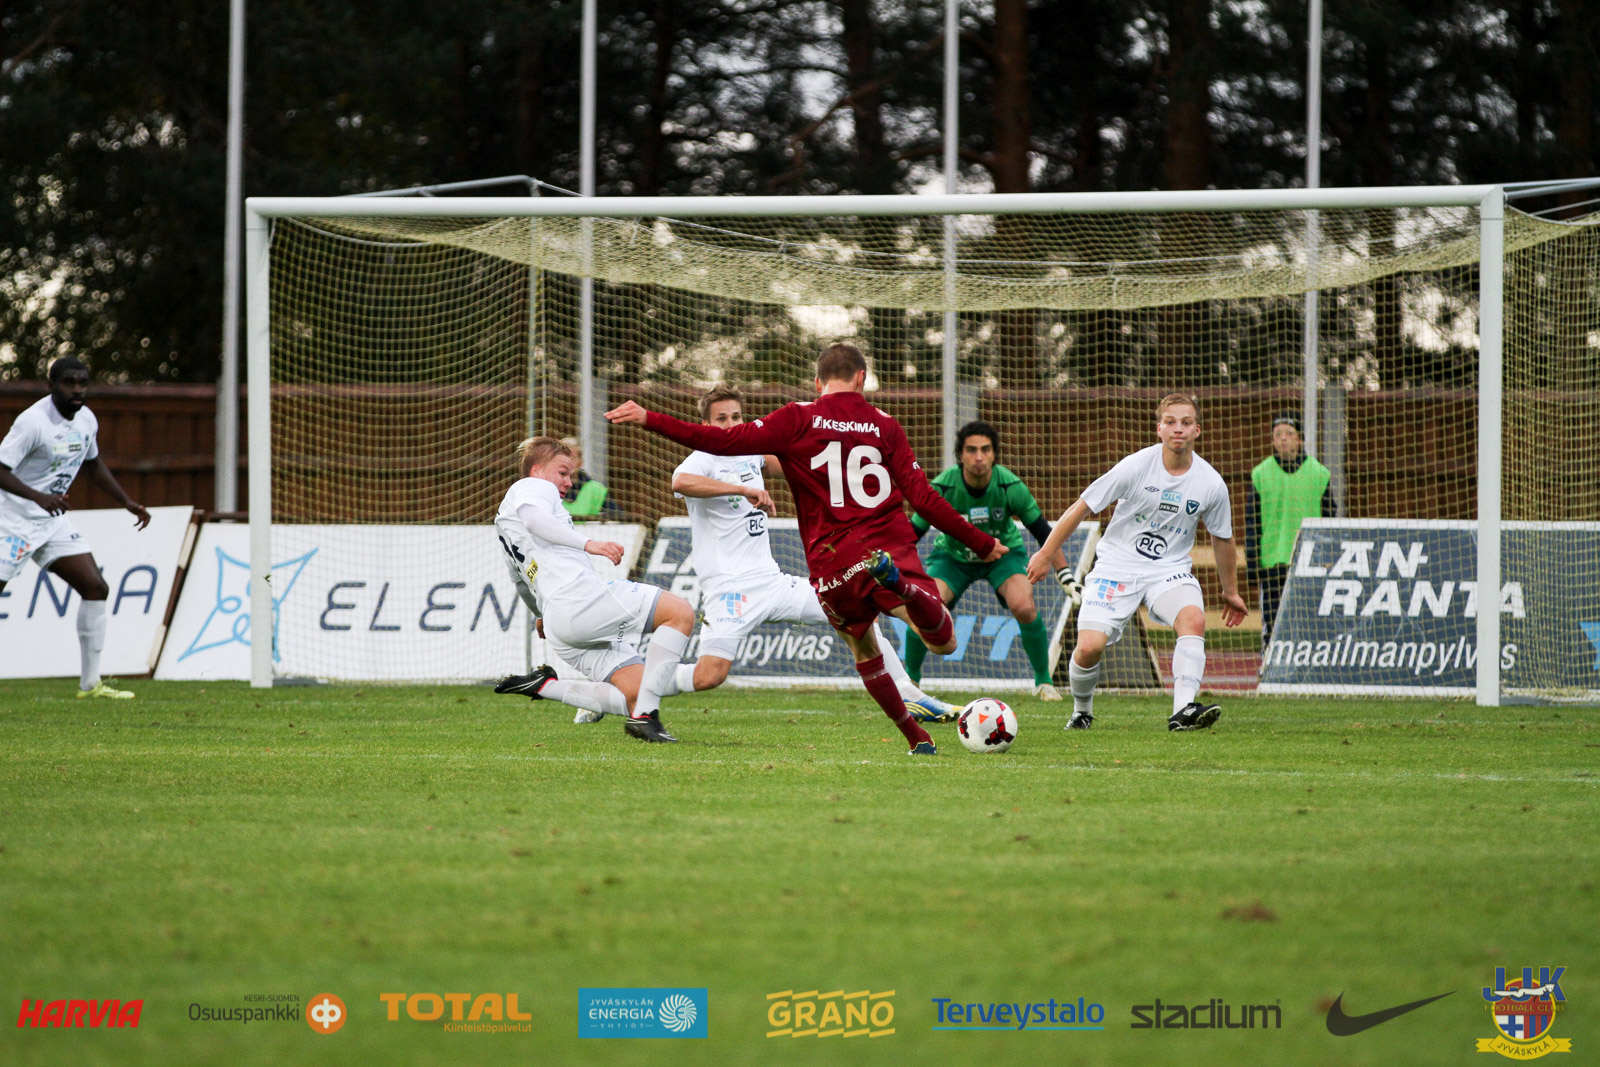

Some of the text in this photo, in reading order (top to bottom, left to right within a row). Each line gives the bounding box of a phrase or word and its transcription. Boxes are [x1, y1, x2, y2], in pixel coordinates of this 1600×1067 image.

[811, 441, 891, 508] 16
[1163, 491, 1182, 502] OTC
[1139, 537, 1165, 555] PLC
[320, 582, 537, 632] ELEN
[1318, 579, 1526, 618] RANTA
[1266, 633, 1518, 676] maailmanpylvs
